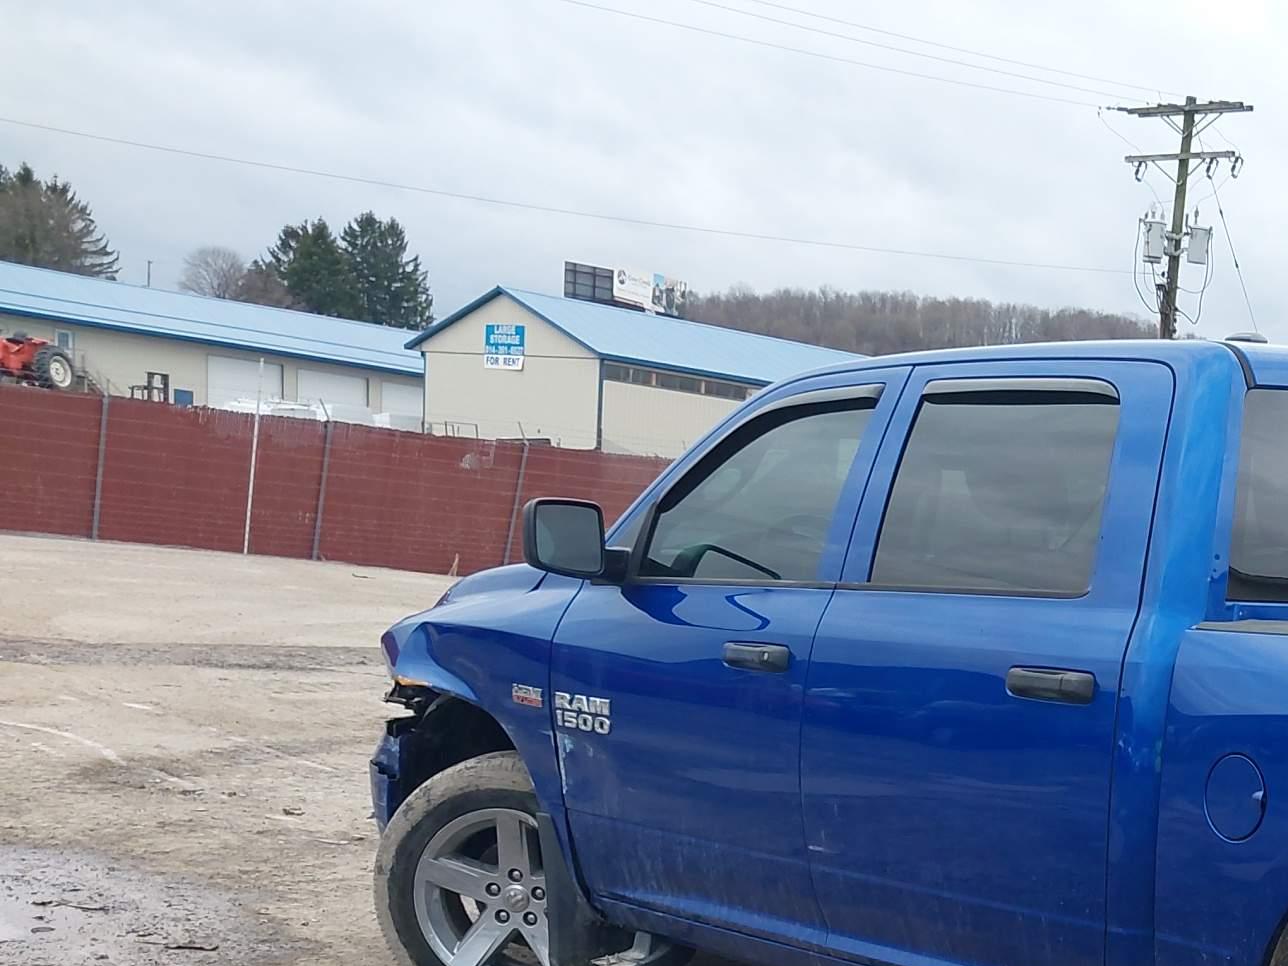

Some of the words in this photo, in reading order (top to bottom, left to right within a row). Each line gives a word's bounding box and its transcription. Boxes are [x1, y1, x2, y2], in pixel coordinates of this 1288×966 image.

[489, 334, 521, 345] STORAGE
[485, 356, 500, 366] FOR
[503, 357, 521, 367] RENT
[554, 691, 611, 716] RAM
[555, 710, 611, 735] 1500
